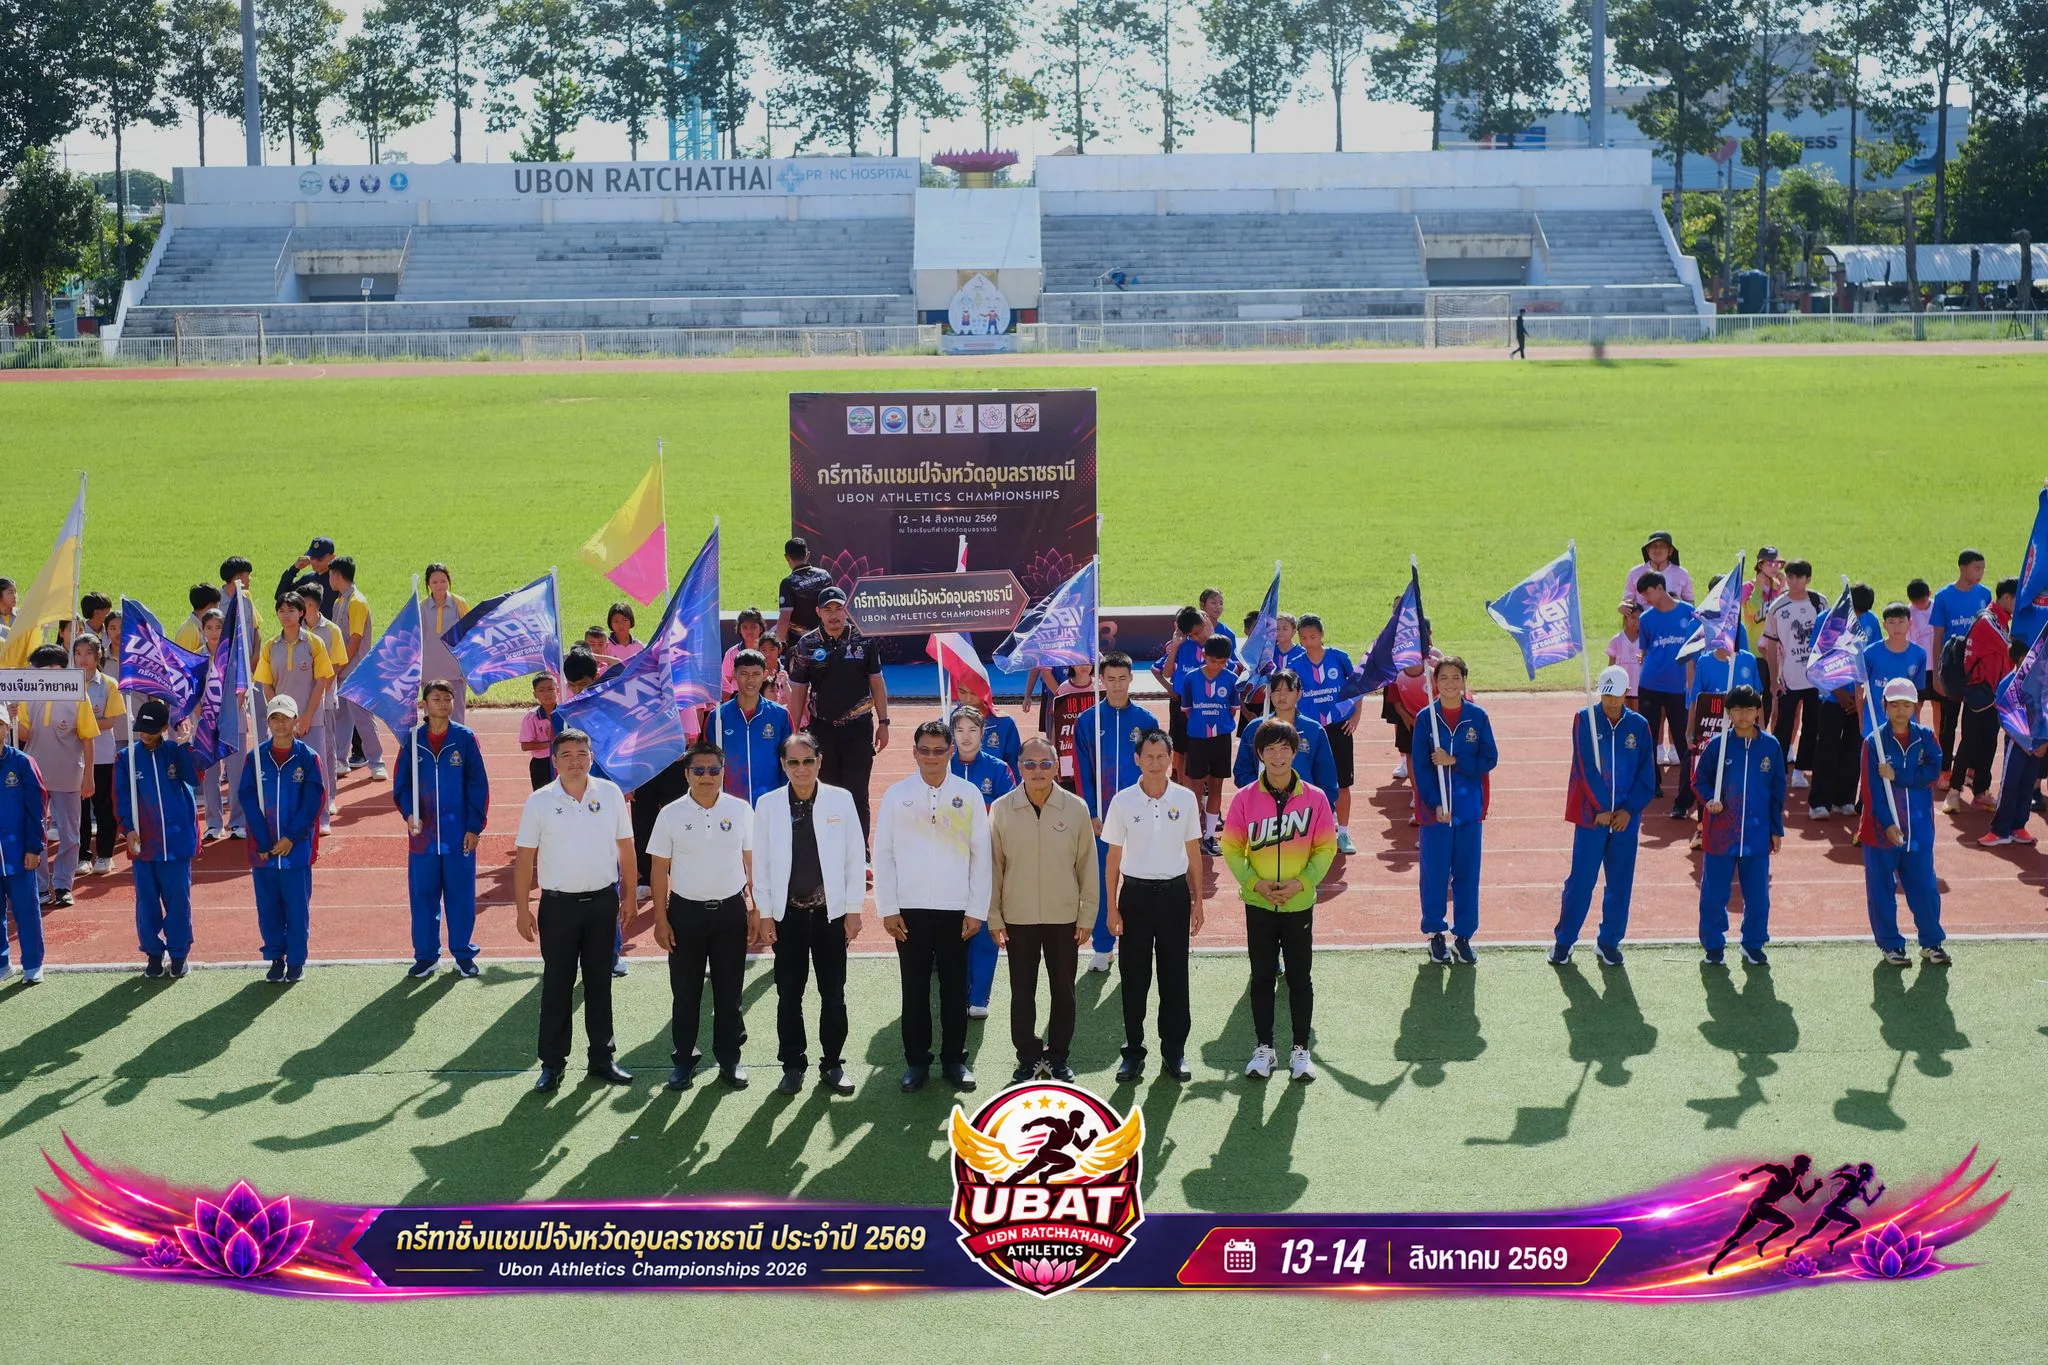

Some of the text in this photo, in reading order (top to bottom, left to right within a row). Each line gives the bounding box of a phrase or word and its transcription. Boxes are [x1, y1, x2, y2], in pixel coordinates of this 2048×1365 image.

[515, 168, 593, 193] UBON
[851, 168, 912, 180] HOSPITAL
[817, 459, 1075, 489] กรีฑาชิงแชมป์จังหวัดอุบลราชธานี
[837, 490, 1060, 503] UBON ATHLETICS CHAMPIONSHIPS
[898, 515, 909, 524] 12
[921, 515, 931, 524] 14
[935, 515, 972, 523] สิงหาคม
[975, 514, 997, 523] 2569
[854, 584, 1014, 609] กรีฑาชิงแชมป์จังหวัดอุบลราชธานี
[861, 608, 1010, 622] UBON ATHLETICS CHAMPIONSHIPS
[1248, 806, 1313, 851] UBN
